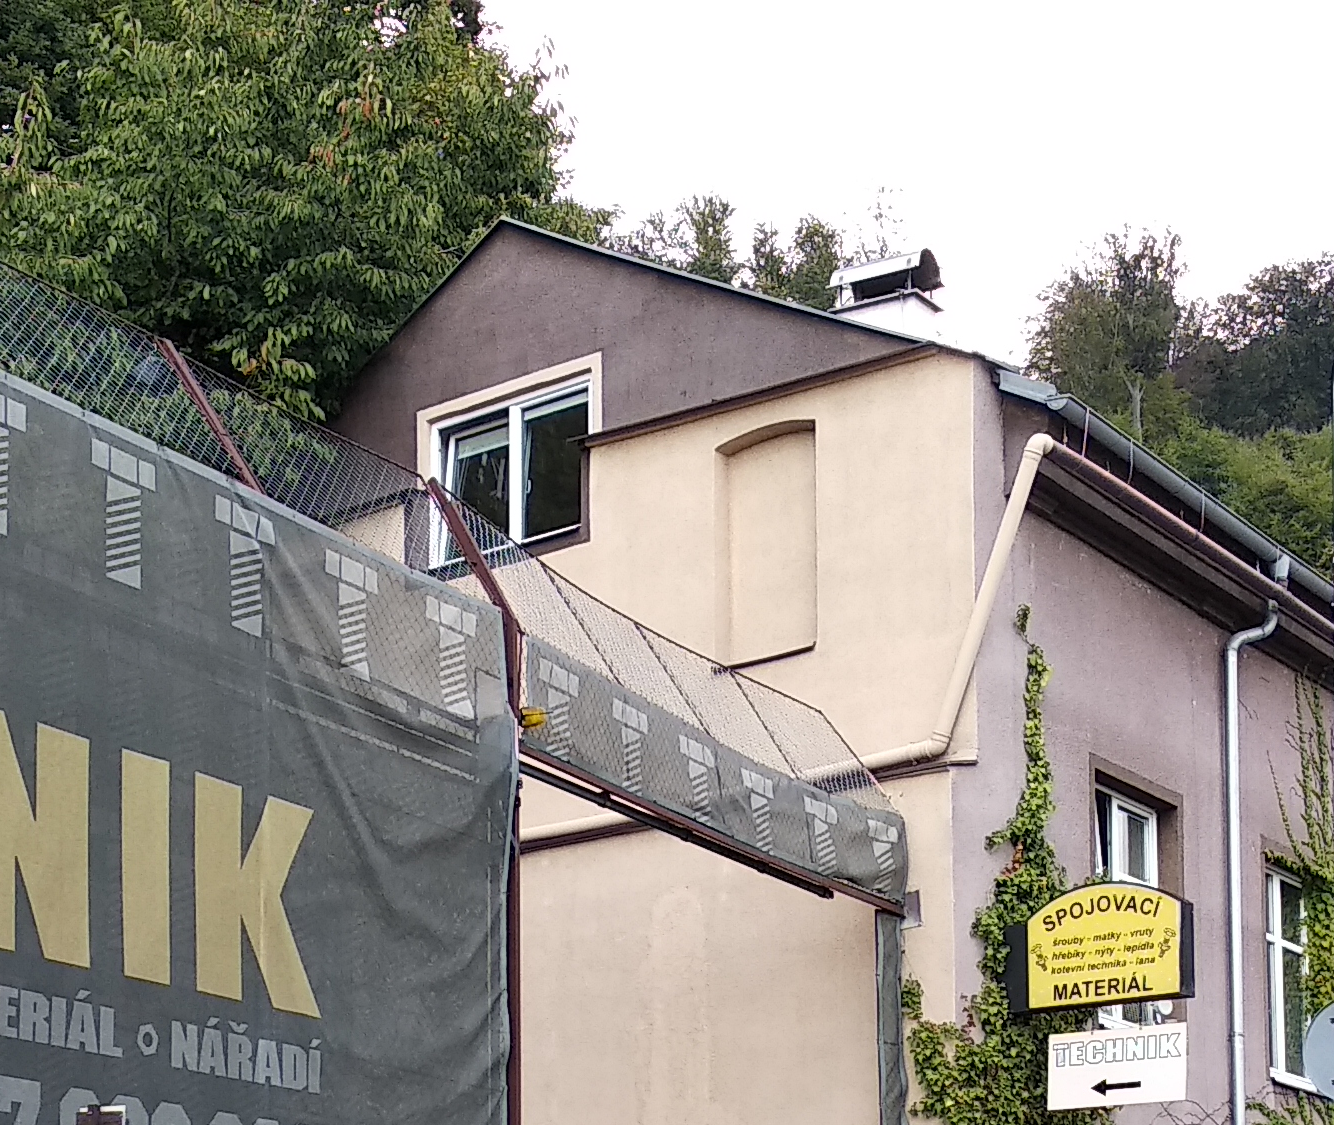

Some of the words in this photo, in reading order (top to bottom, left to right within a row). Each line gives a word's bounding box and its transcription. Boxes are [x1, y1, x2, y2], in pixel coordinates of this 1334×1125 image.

[1042, 894, 1163, 932] SPOJOVACÍ
[1051, 950, 1086, 961] hřebíky
[1094, 945, 1115, 957] nýty
[1123, 941, 1154, 954] lepidla
[1052, 936, 1085, 947] šrouby
[1092, 931, 1122, 942] matky
[1129, 927, 1154, 938] vruty
[1051, 963, 1085, 975] kotevní
[1087, 958, 1127, 971] technika
[1135, 956, 1156, 966] lana
[1053, 971, 1154, 1001] MATERIÁL
[171, 1016, 322, 1095] NÁŘADÍ
[1052, 1033, 1181, 1067] TECHNIK
